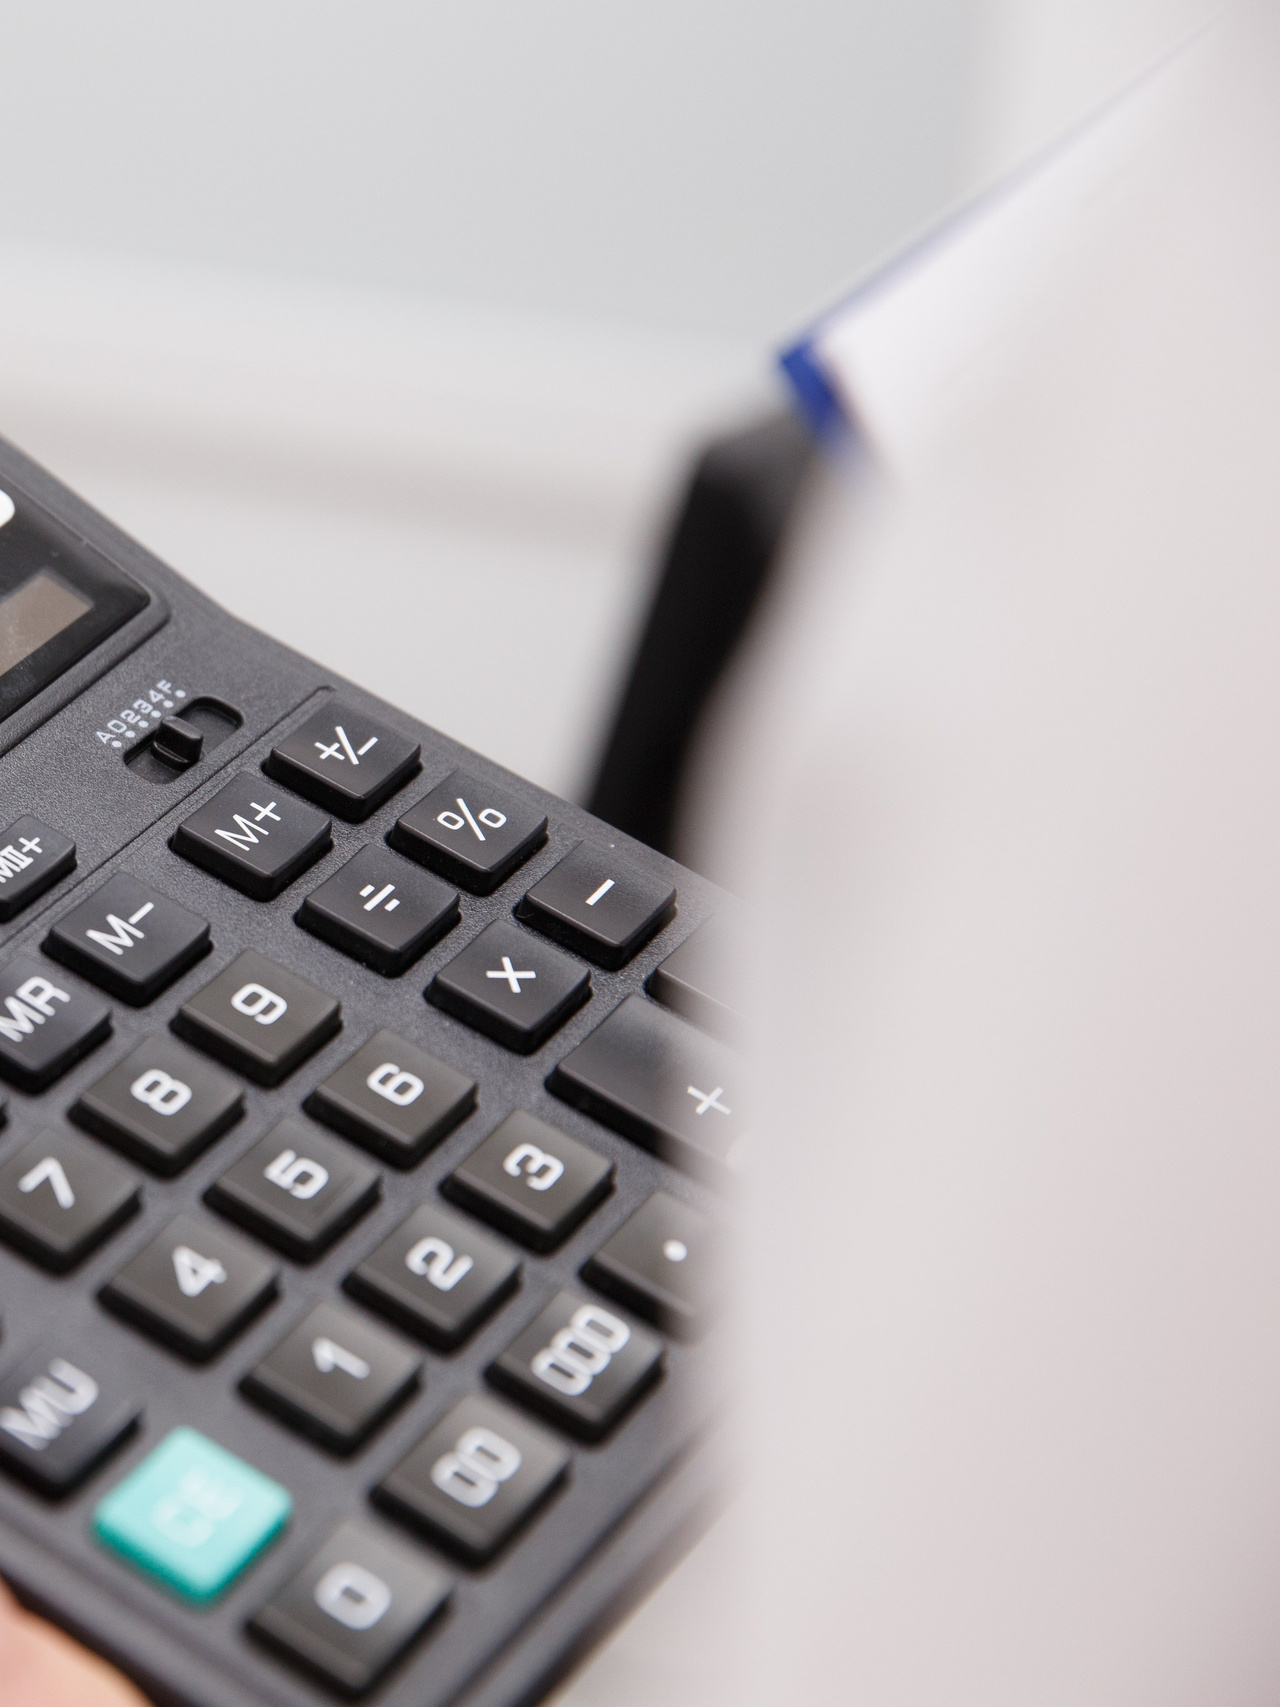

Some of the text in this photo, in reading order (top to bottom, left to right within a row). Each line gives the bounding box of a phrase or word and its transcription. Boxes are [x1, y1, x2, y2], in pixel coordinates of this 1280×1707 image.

[214, 801, 282, 851] M+
[436, 797, 507, 841] %
[85, 902, 154, 955] M-
[231, 983, 288, 1025] 9
[130, 1069, 192, 1116] 8
[366, 1062, 425, 1106] 6
[18, 1156, 76, 1209] 7
[263, 1148, 329, 1200] 5
[502, 1143, 565, 1191] 3
[172, 1245, 227, 1297] 4
[405, 1236, 474, 1291] 2
[312, 1336, 370, 1380] 1
[530, 1304, 631, 1396] 000
[430, 1426, 521, 1508] 00
[314, 1562, 392, 1630] 0
